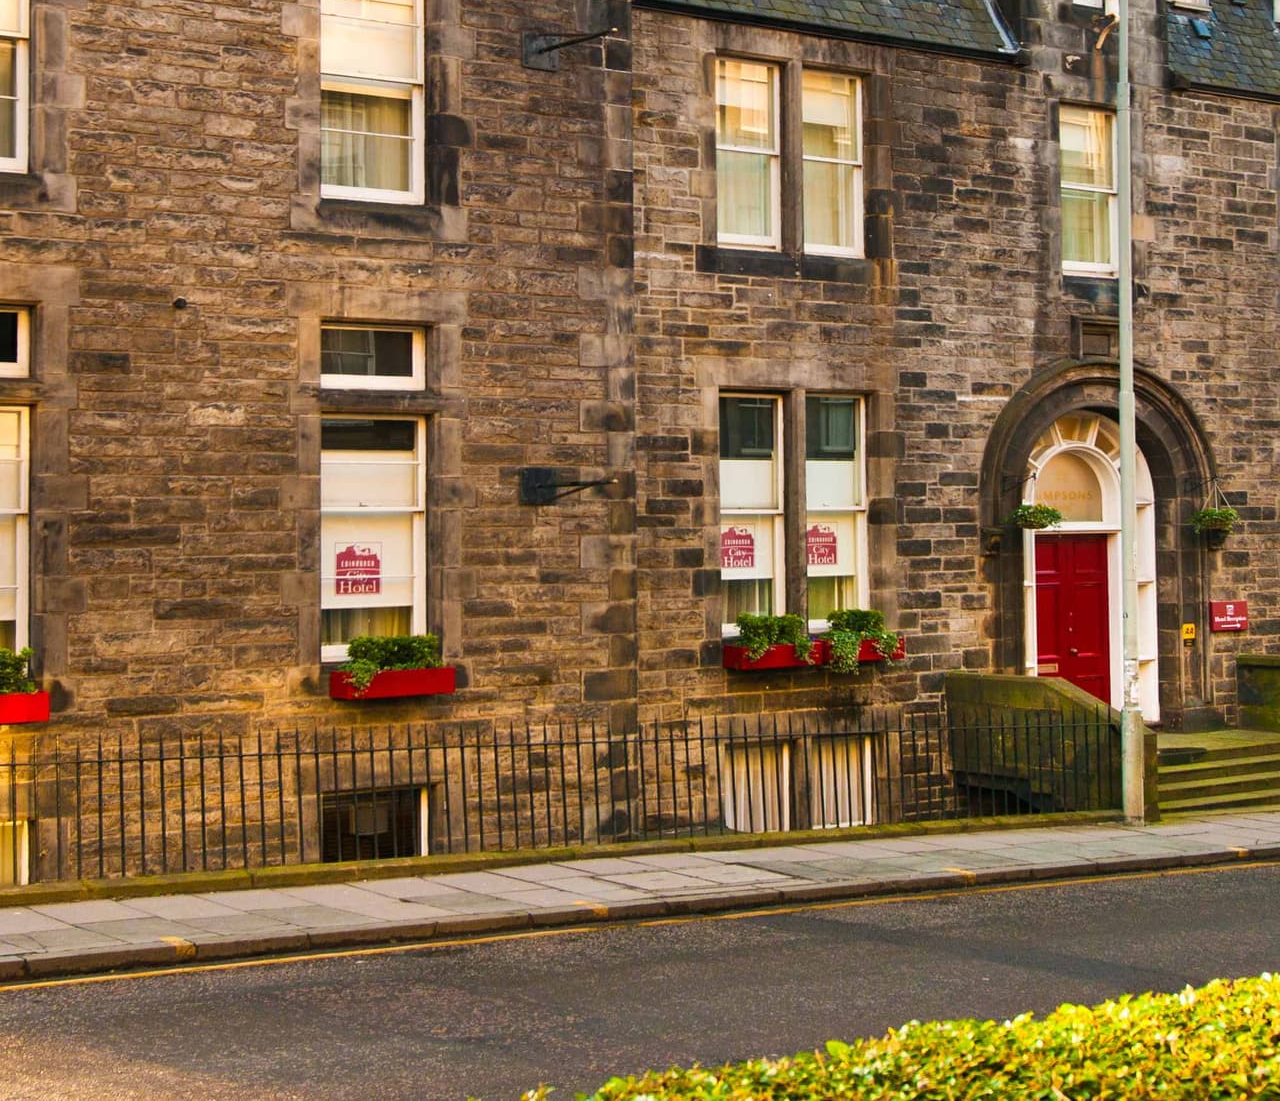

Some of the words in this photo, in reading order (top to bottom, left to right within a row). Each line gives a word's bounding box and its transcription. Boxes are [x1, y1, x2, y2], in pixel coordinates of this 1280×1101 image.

[728, 547, 747, 559] City
[812, 545, 830, 556] City
[723, 556, 752, 567] Hotel
[808, 553, 835, 564] Hotel
[340, 580, 376, 593] Hotel
